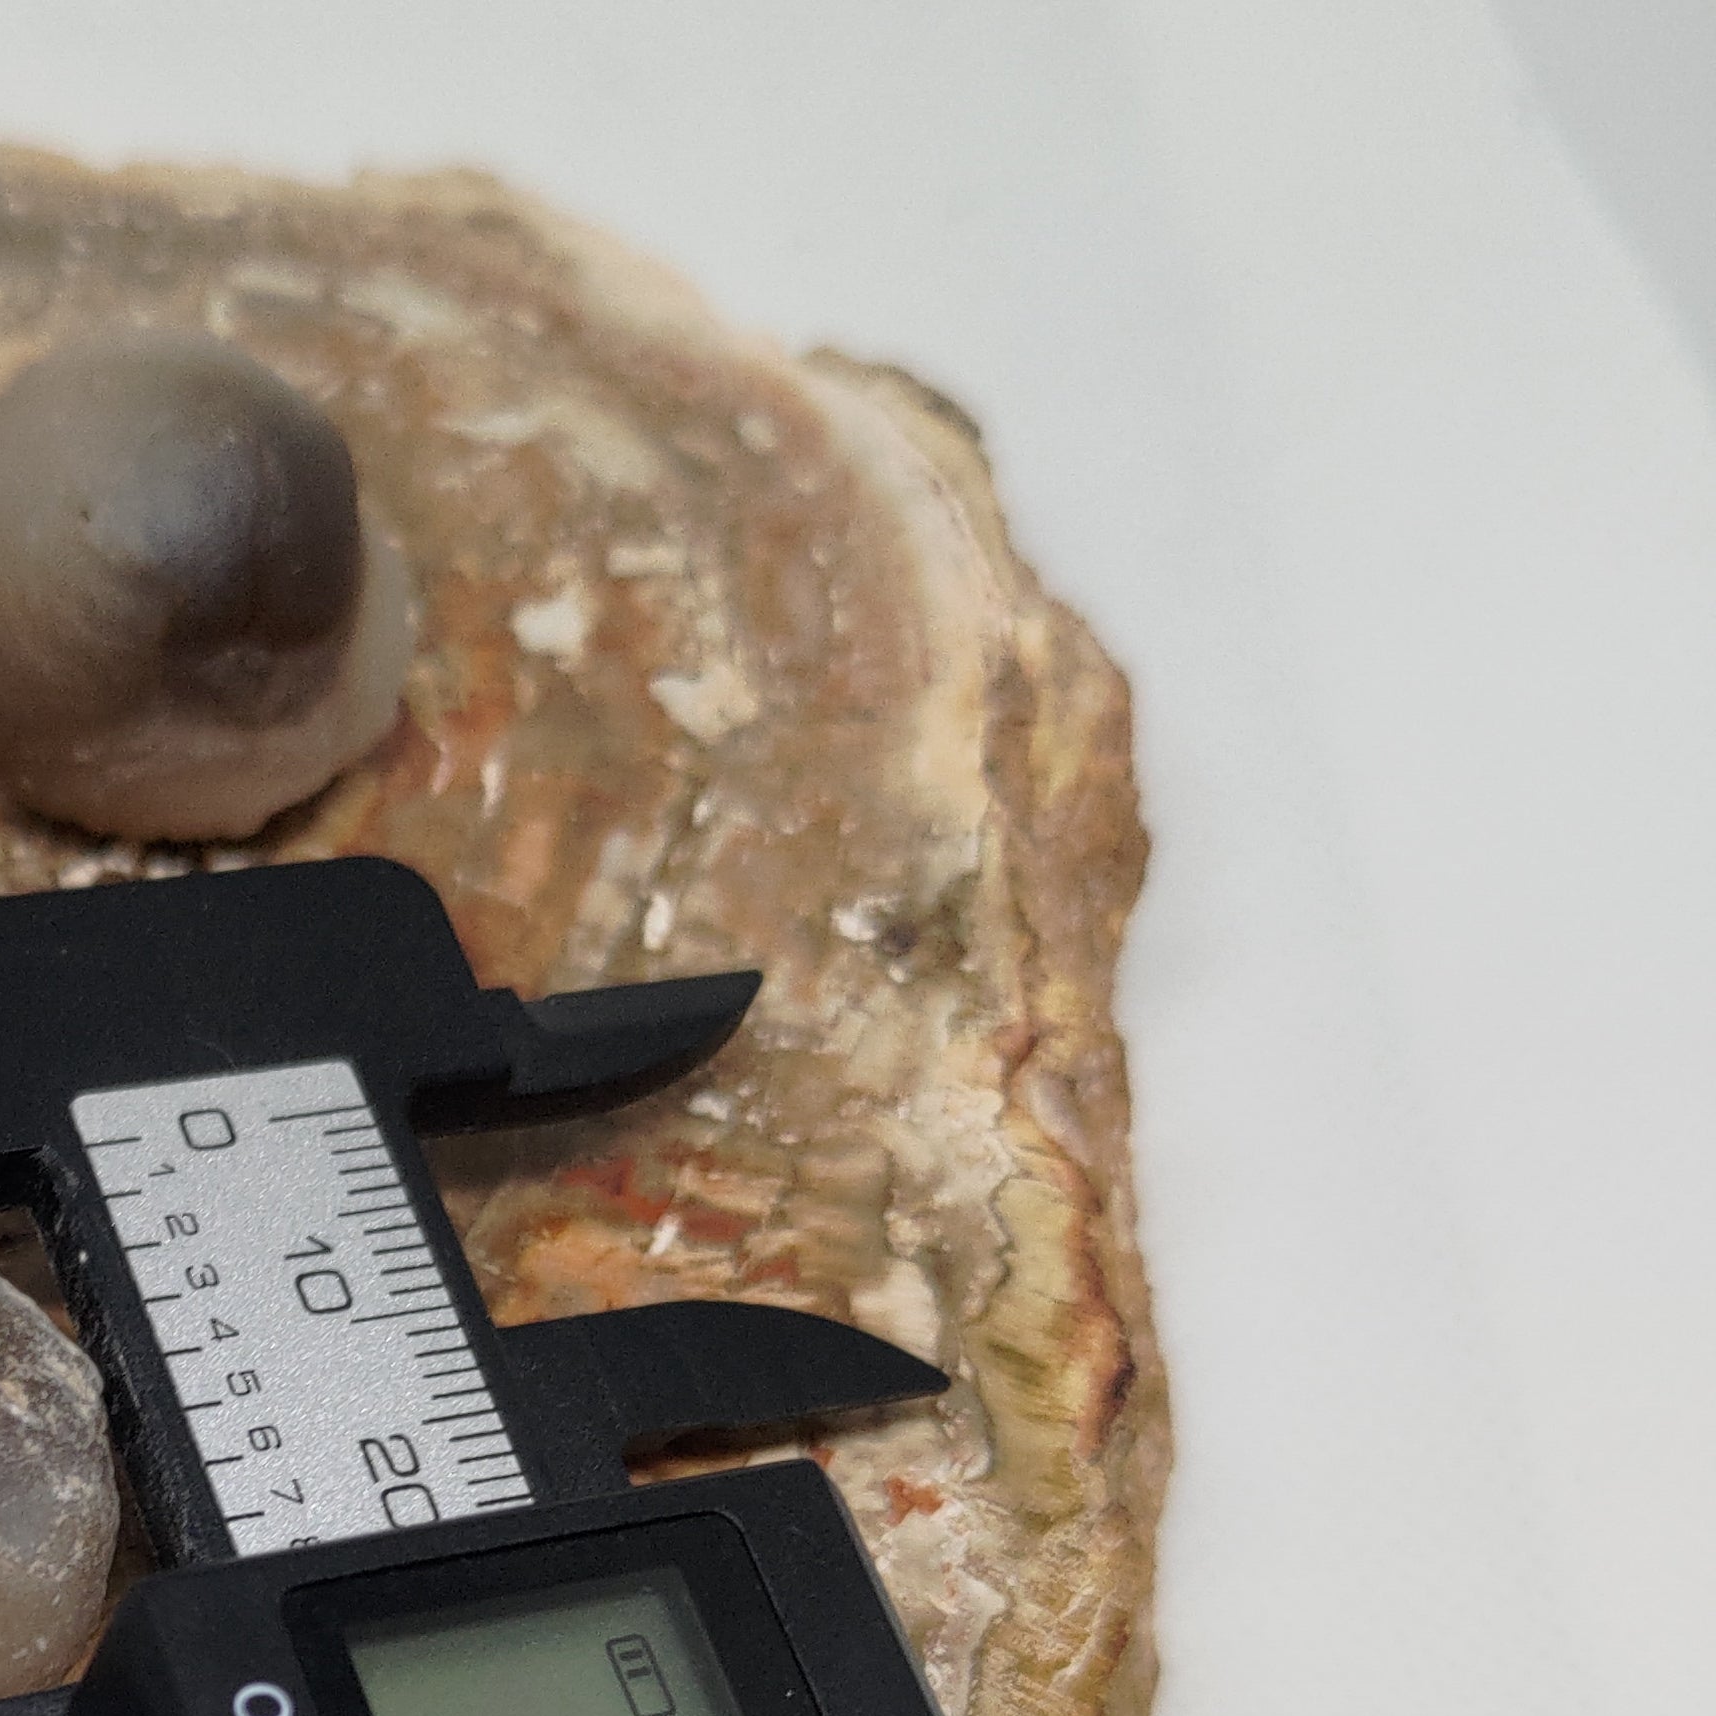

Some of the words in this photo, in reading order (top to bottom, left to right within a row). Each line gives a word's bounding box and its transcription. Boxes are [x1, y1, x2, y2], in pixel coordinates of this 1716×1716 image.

[148, 1161, 177, 1179] 1
[163, 1211, 201, 1241] 2
[184, 1262, 222, 1292] 3
[177, 1106, 238, 1153] 0
[283, 1234, 354, 1316] 10
[357, 1432, 441, 1529] 20
[209, 1316, 241, 1344] 4
[224, 1368, 263, 1398] 5
[246, 1423, 284, 1454] 6
[269, 1477, 306, 1506] 7
